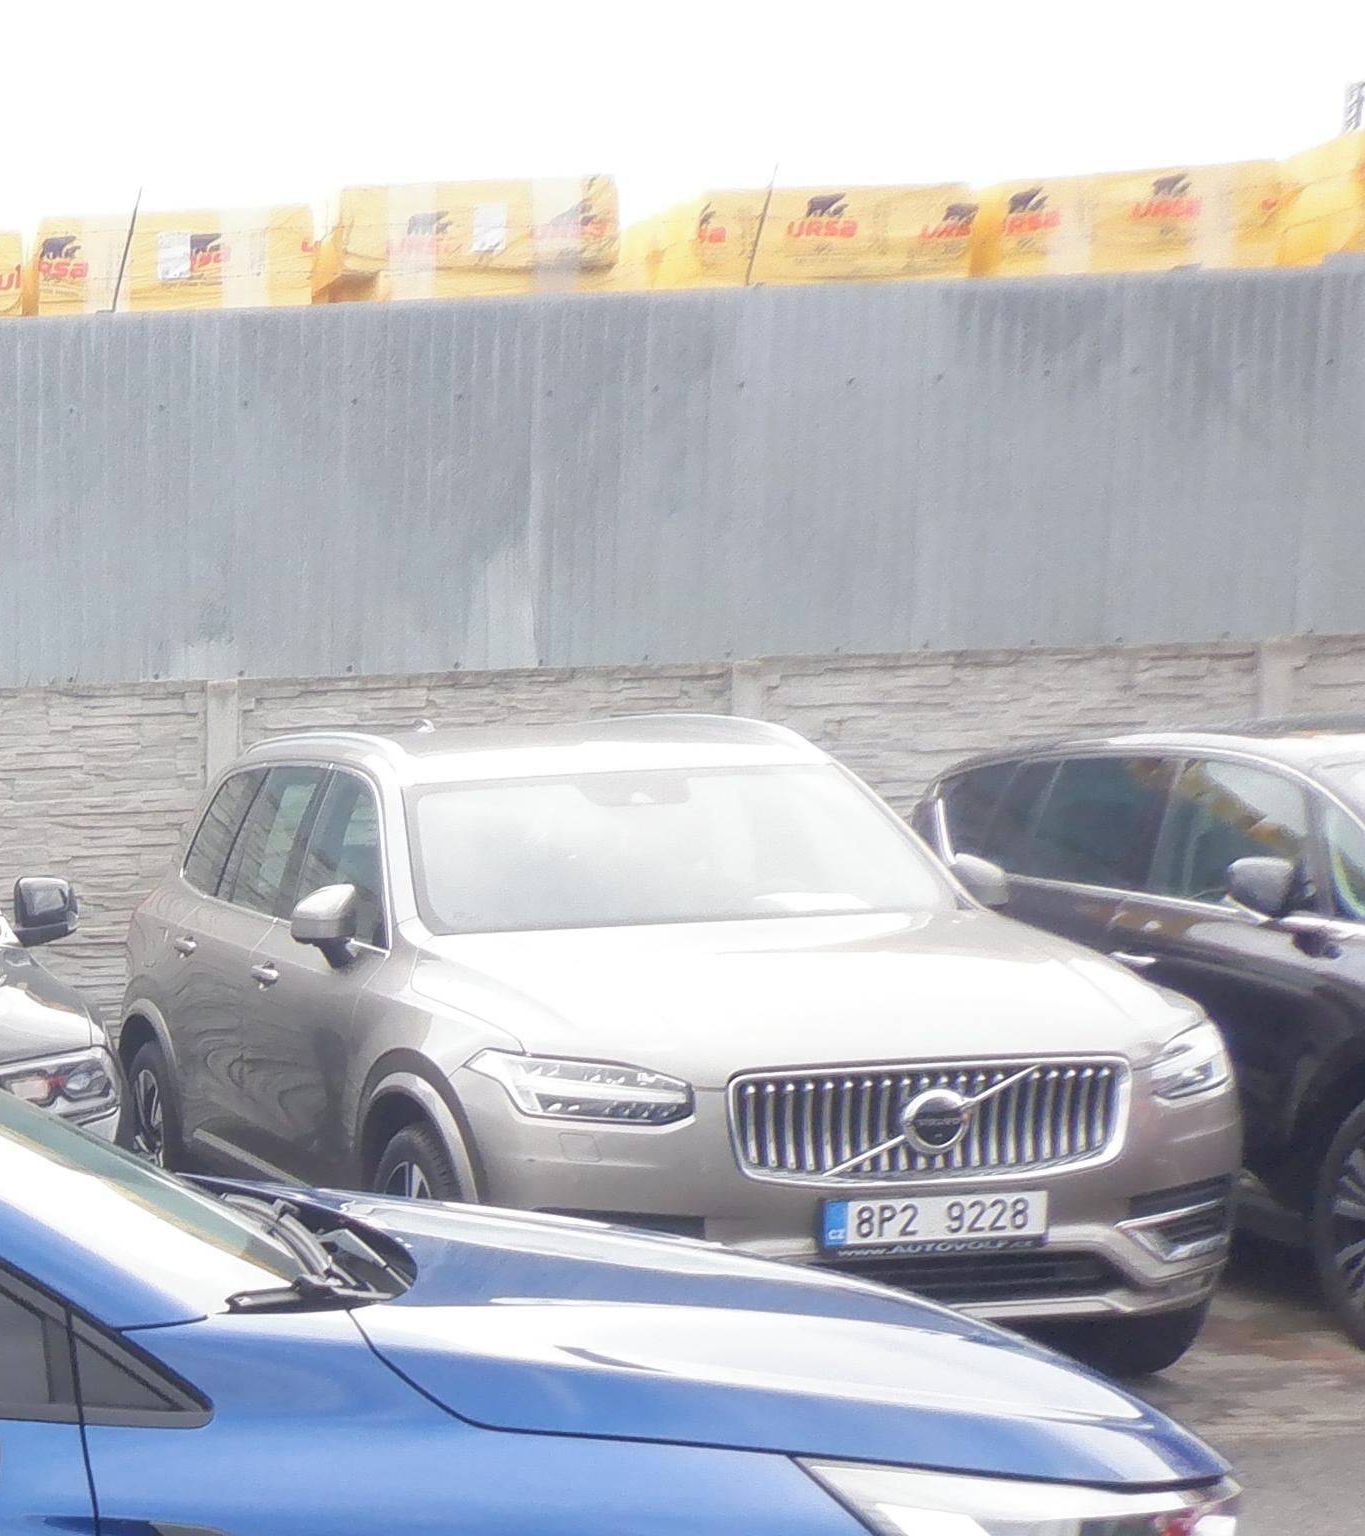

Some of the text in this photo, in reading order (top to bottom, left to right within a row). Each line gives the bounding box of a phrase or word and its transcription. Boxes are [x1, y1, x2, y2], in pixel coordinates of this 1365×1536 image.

[856, 1197, 1030, 1239] 8P2 9228
[828, 1228, 846, 1240] CZ
